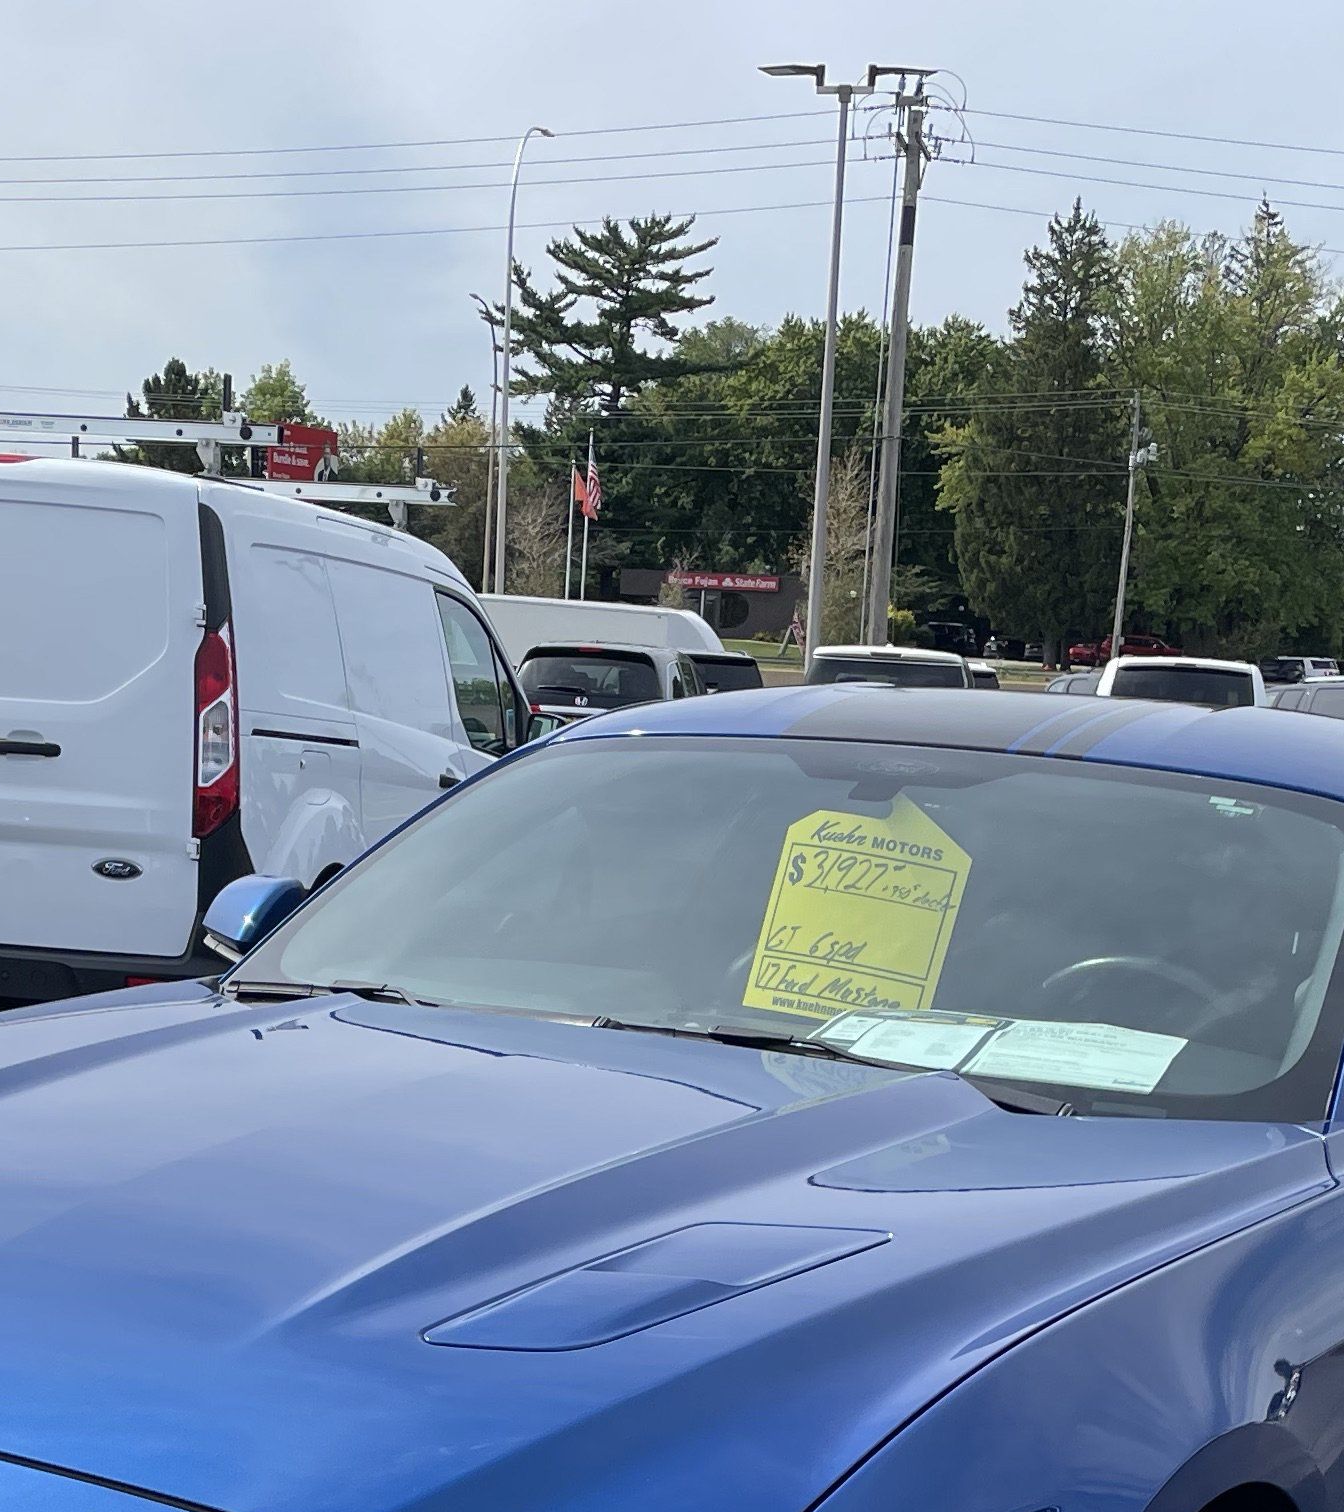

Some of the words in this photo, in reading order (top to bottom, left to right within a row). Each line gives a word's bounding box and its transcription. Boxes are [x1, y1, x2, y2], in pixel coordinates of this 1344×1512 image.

[810, 820, 868, 847] Kuehn
[871, 836, 945, 862] MOTORS
[102, 861, 131, 876] Ford
